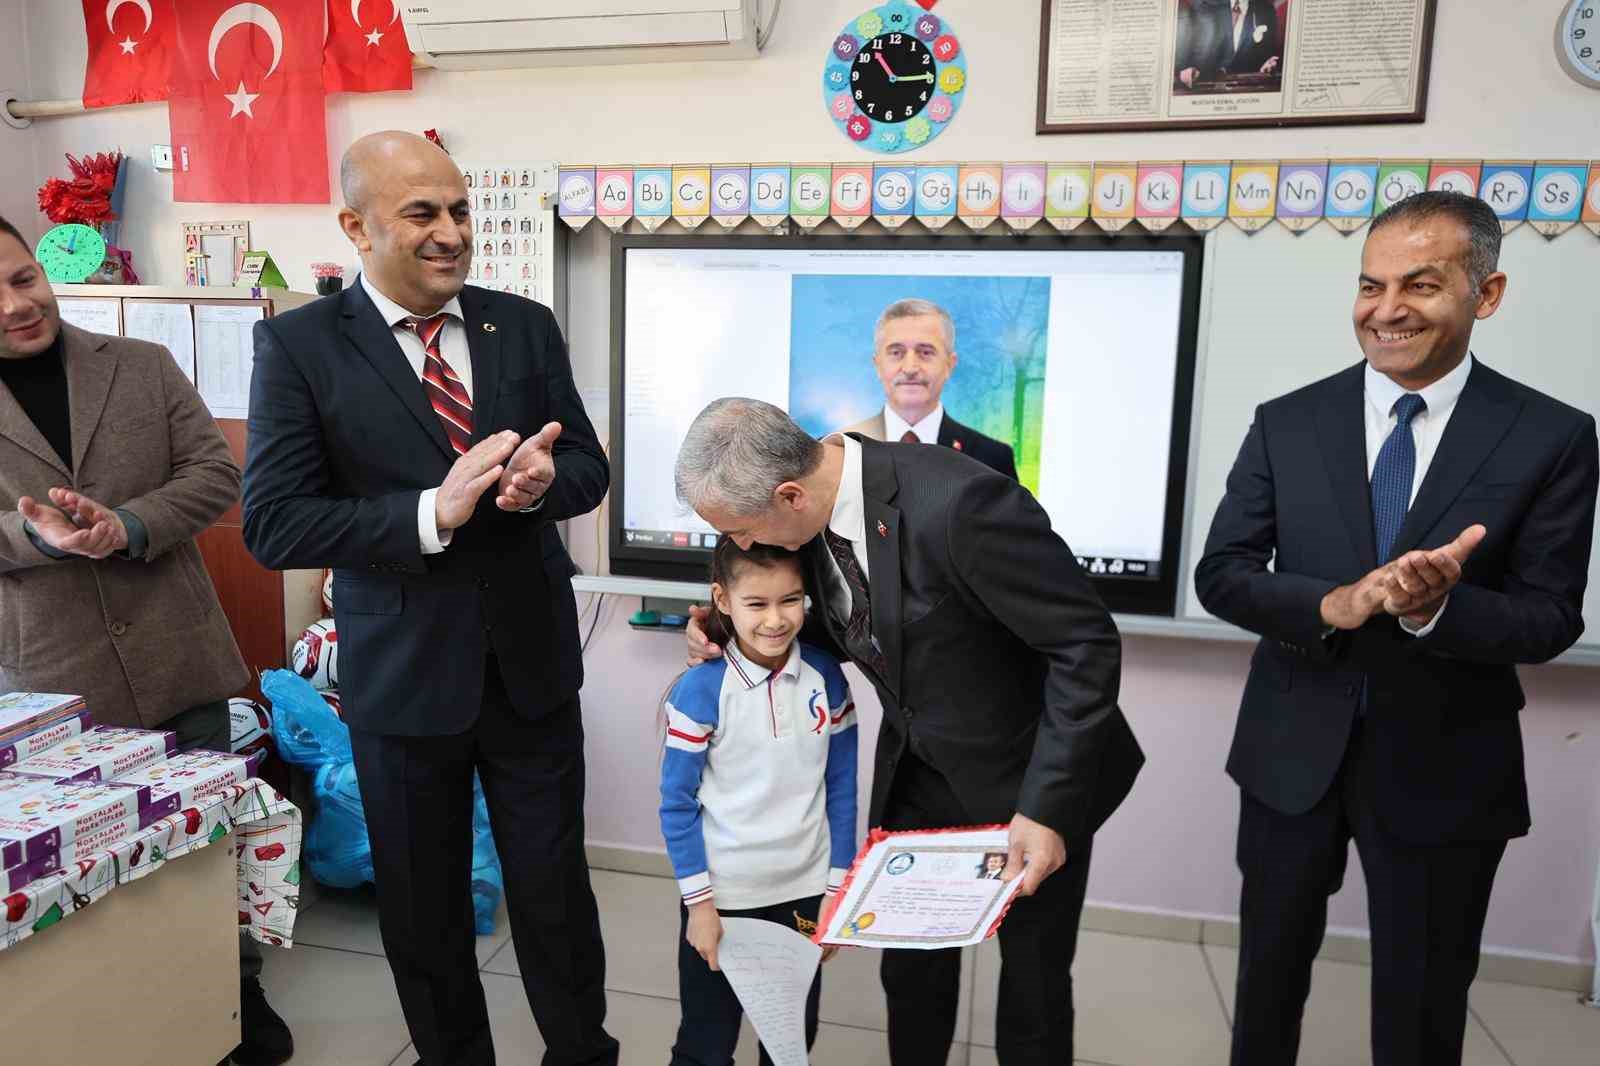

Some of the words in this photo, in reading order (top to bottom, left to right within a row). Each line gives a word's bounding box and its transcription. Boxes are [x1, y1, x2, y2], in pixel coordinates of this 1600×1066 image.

[891, 14, 903, 23] 00
[1581, 7, 1594, 20] 10
[919, 20, 934, 35] 05
[1574, 28, 1586, 40] 9
[838, 40, 852, 54] 50
[872, 39, 883, 50] 11
[888, 34, 902, 45] 12
[910, 41, 916, 52] 1
[938, 42, 952, 55] 10
[858, 53, 871, 64] 10
[922, 54, 931, 65] 2
[1580, 47, 1592, 58] 8
[830, 72, 843, 82] 45
[852, 71, 859, 82] 9
[855, 90, 863, 100] 8
[919, 91, 927, 102] 4
[867, 103, 875, 114] 7
[885, 111, 893, 120] 6
[905, 106, 913, 116] 5
[603, 183, 627, 201] Aa
[642, 183, 664, 201] Bb
[679, 183, 704, 201] Cc
[718, 182, 743, 204] Çç
[757, 180, 783, 200] Dd
[800, 181, 822, 201] Ee
[841, 182, 863, 201] Ff
[878, 179, 907, 206] Gg
[966, 181, 992, 201] Hh
[1103, 179, 1125, 207] Jj
[1147, 181, 1170, 201] Kk
[1235, 182, 1270, 200] Mm
[1285, 180, 1317, 201] Nn
[1334, 180, 1368, 201] Oo
[1491, 182, 1518, 203] Rr
[1543, 182, 1570, 204] Ss
[1544, 222, 1560, 234] 22
[28, 724, 70, 745] NOKTALAMA
[113, 745, 154, 766] NOKTALAMA
[193, 770, 234, 793] NOKTALAMA
[76, 801, 124, 827] NOKTALAMA
[76, 822, 125, 848] NOKTALAMA
